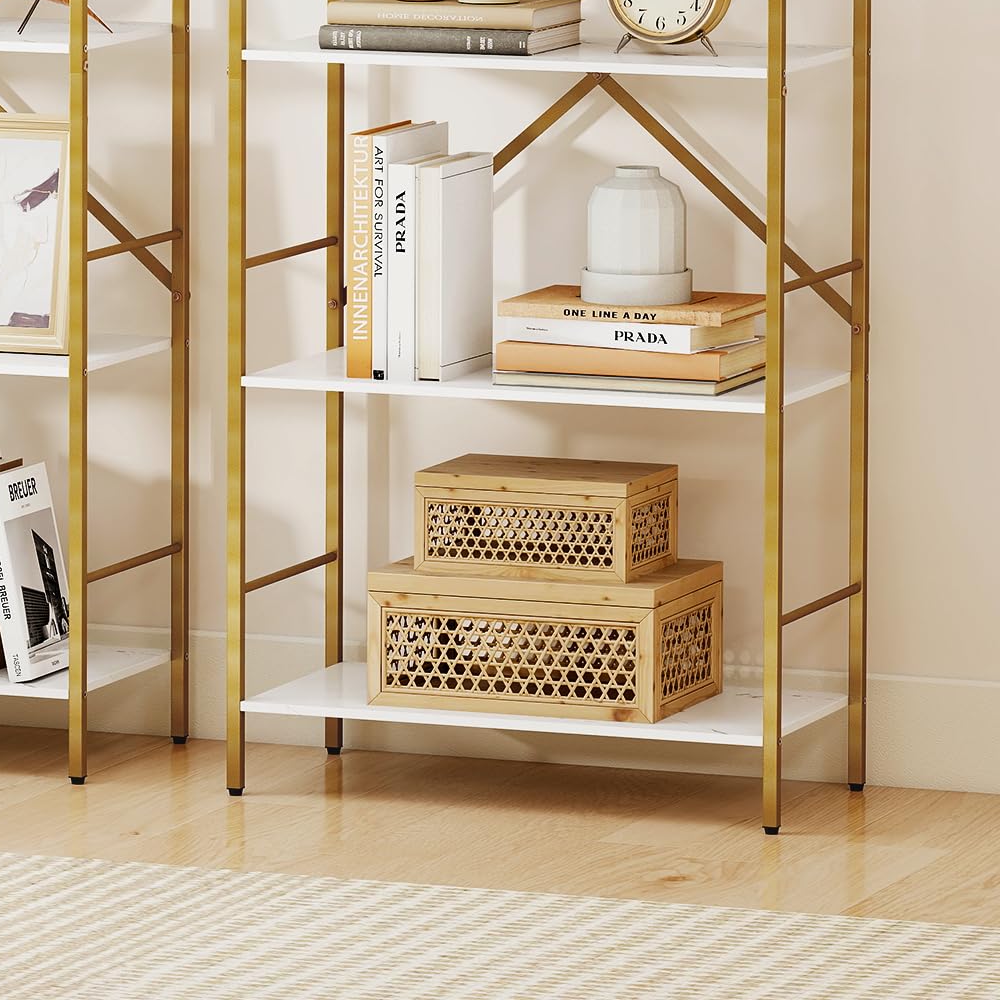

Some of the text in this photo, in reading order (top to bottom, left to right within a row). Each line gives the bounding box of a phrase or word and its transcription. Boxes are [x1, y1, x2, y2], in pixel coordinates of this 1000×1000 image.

[638, 9, 647, 24] 7
[656, 16, 666, 31] 6
[677, 11, 686, 26] 5
[374, 146, 384, 278] ART FOR SURVIVAL
[395, 190, 406, 253] PRADA
[353, 136, 369, 340] INNENARCHITEKTUR
[563, 308, 587, 317] ONE
[592, 310, 618, 319] LINE
[634, 312, 657, 320] DAY
[614, 330, 668, 345] PRADA
[7, 477, 38, 502] BREUER
